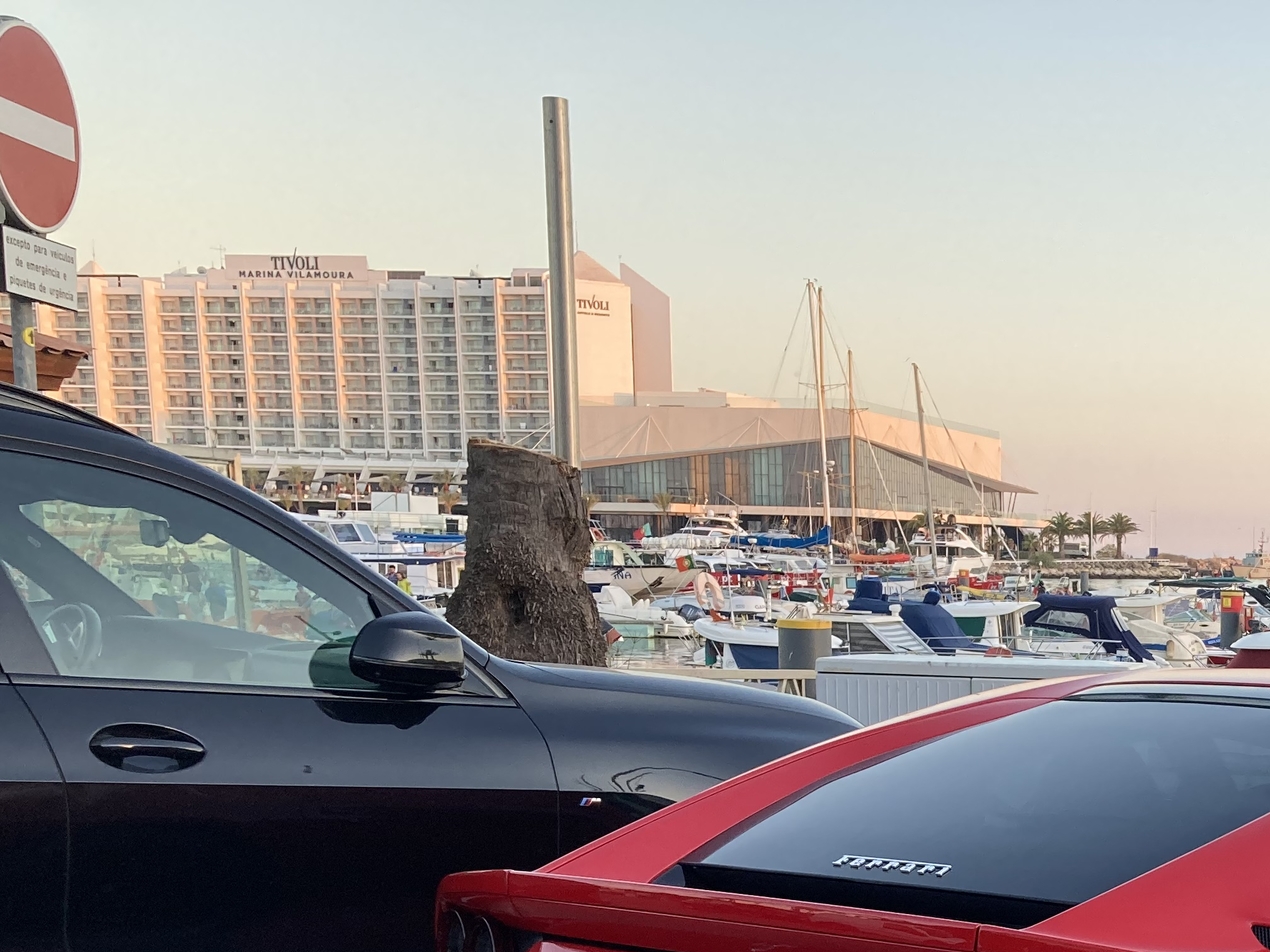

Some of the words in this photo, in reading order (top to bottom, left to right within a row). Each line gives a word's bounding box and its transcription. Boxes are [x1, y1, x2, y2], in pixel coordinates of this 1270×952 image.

[6, 235, 31, 249] excepto
[34, 244, 47, 256] para
[15, 256, 23, 268] de
[63, 273, 67, 281] e
[271, 247, 319, 270] TIVOLI
[9, 275, 36, 290] piquetes
[39, 283, 47, 294] de
[239, 270, 282, 278] MARINA
[287, 271, 354, 279] VILAMOURA
[577, 294, 609, 311] TIVOLI
[832, 855, 952, 877] Ferrari
